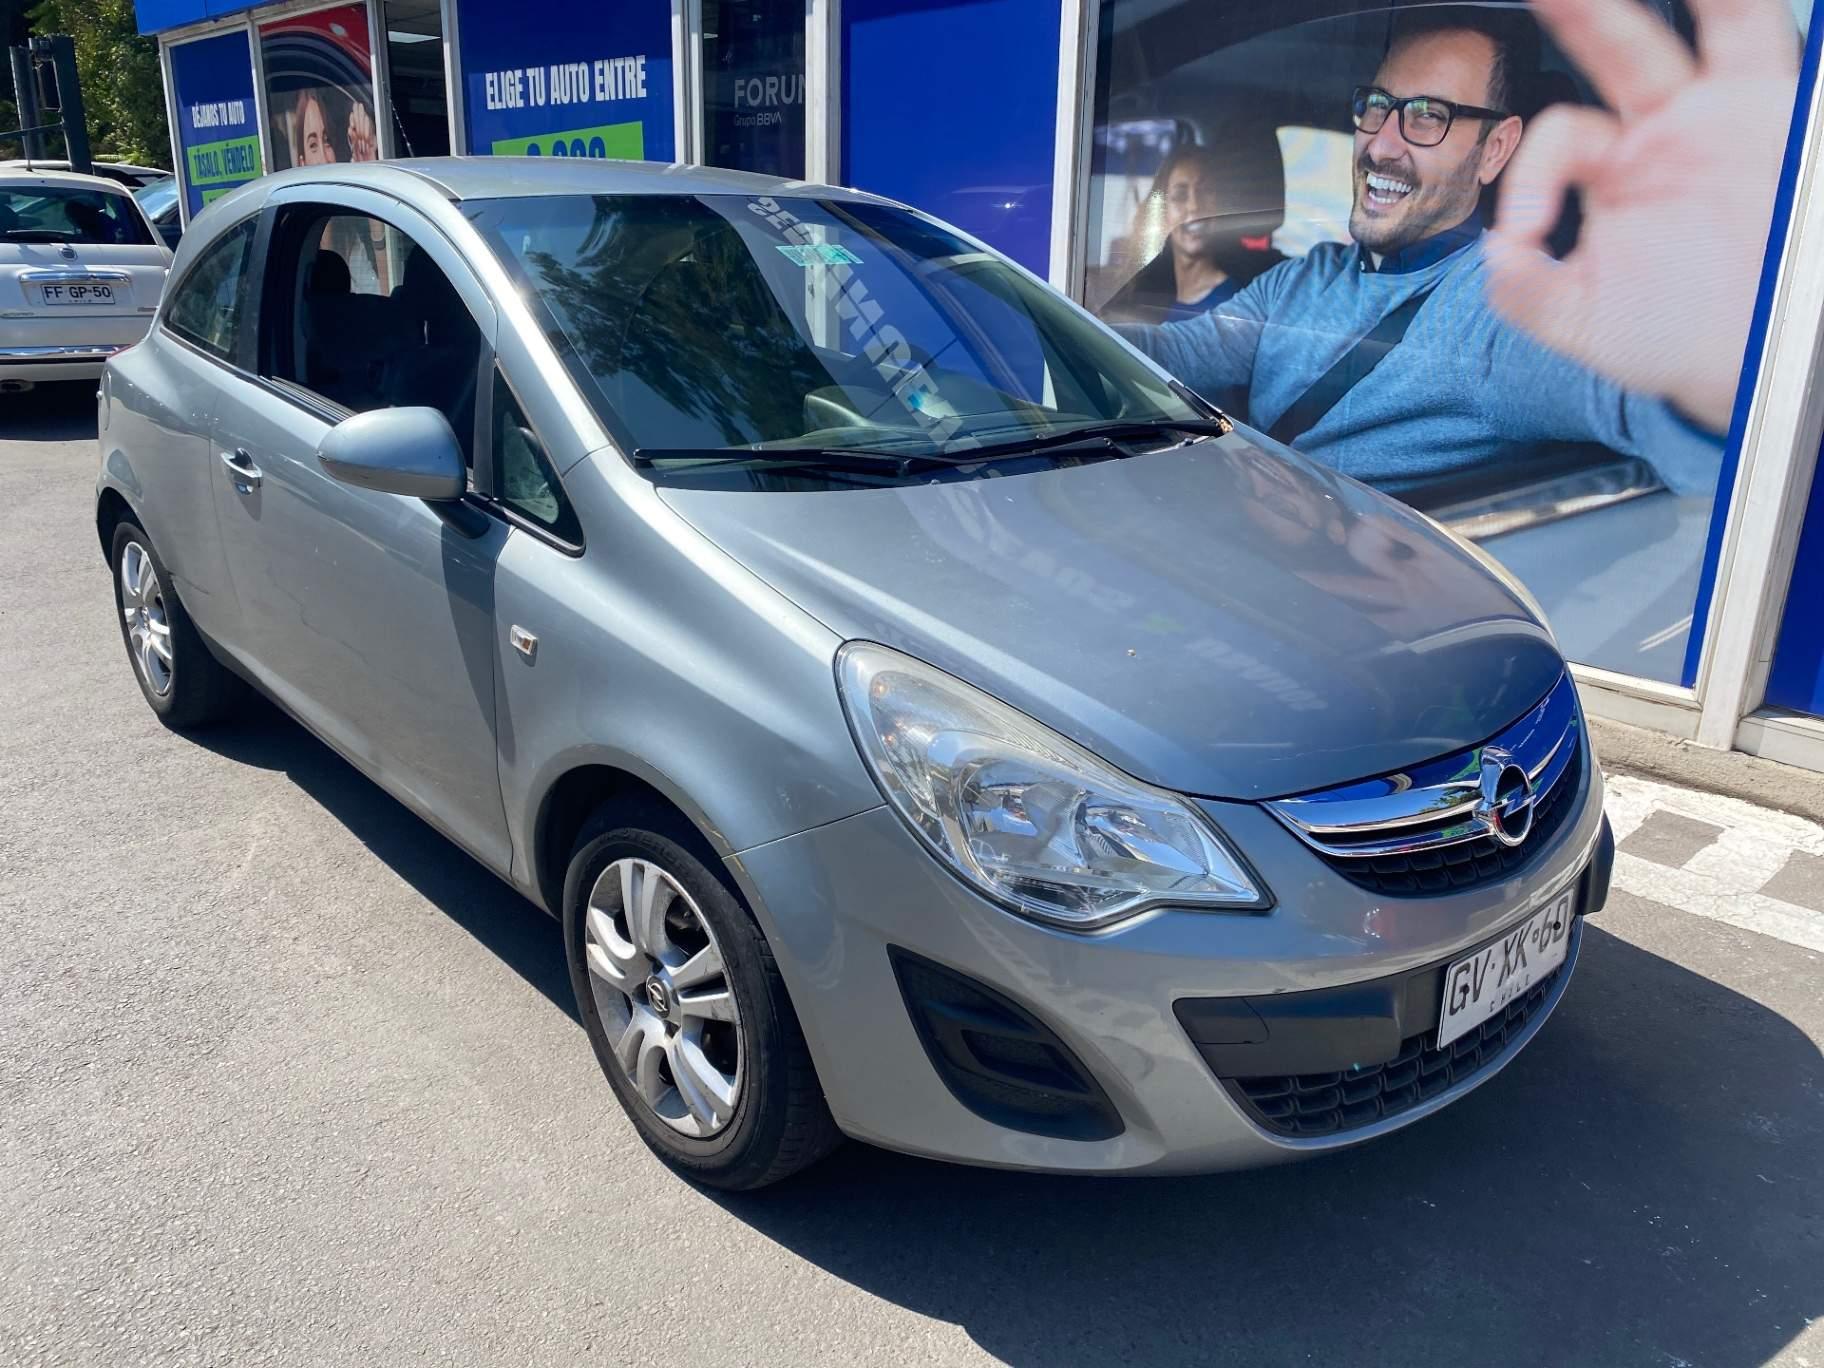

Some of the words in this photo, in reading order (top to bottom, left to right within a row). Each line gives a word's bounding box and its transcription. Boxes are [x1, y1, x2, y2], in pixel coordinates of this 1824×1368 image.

[485, 69, 525, 110] ELIGE
[526, 66, 546, 107] TU
[550, 61, 590, 105] AUTO
[594, 54, 647, 102] ENTRE
[734, 114, 755, 128] Grupo
[756, 112, 783, 126] BBVA
